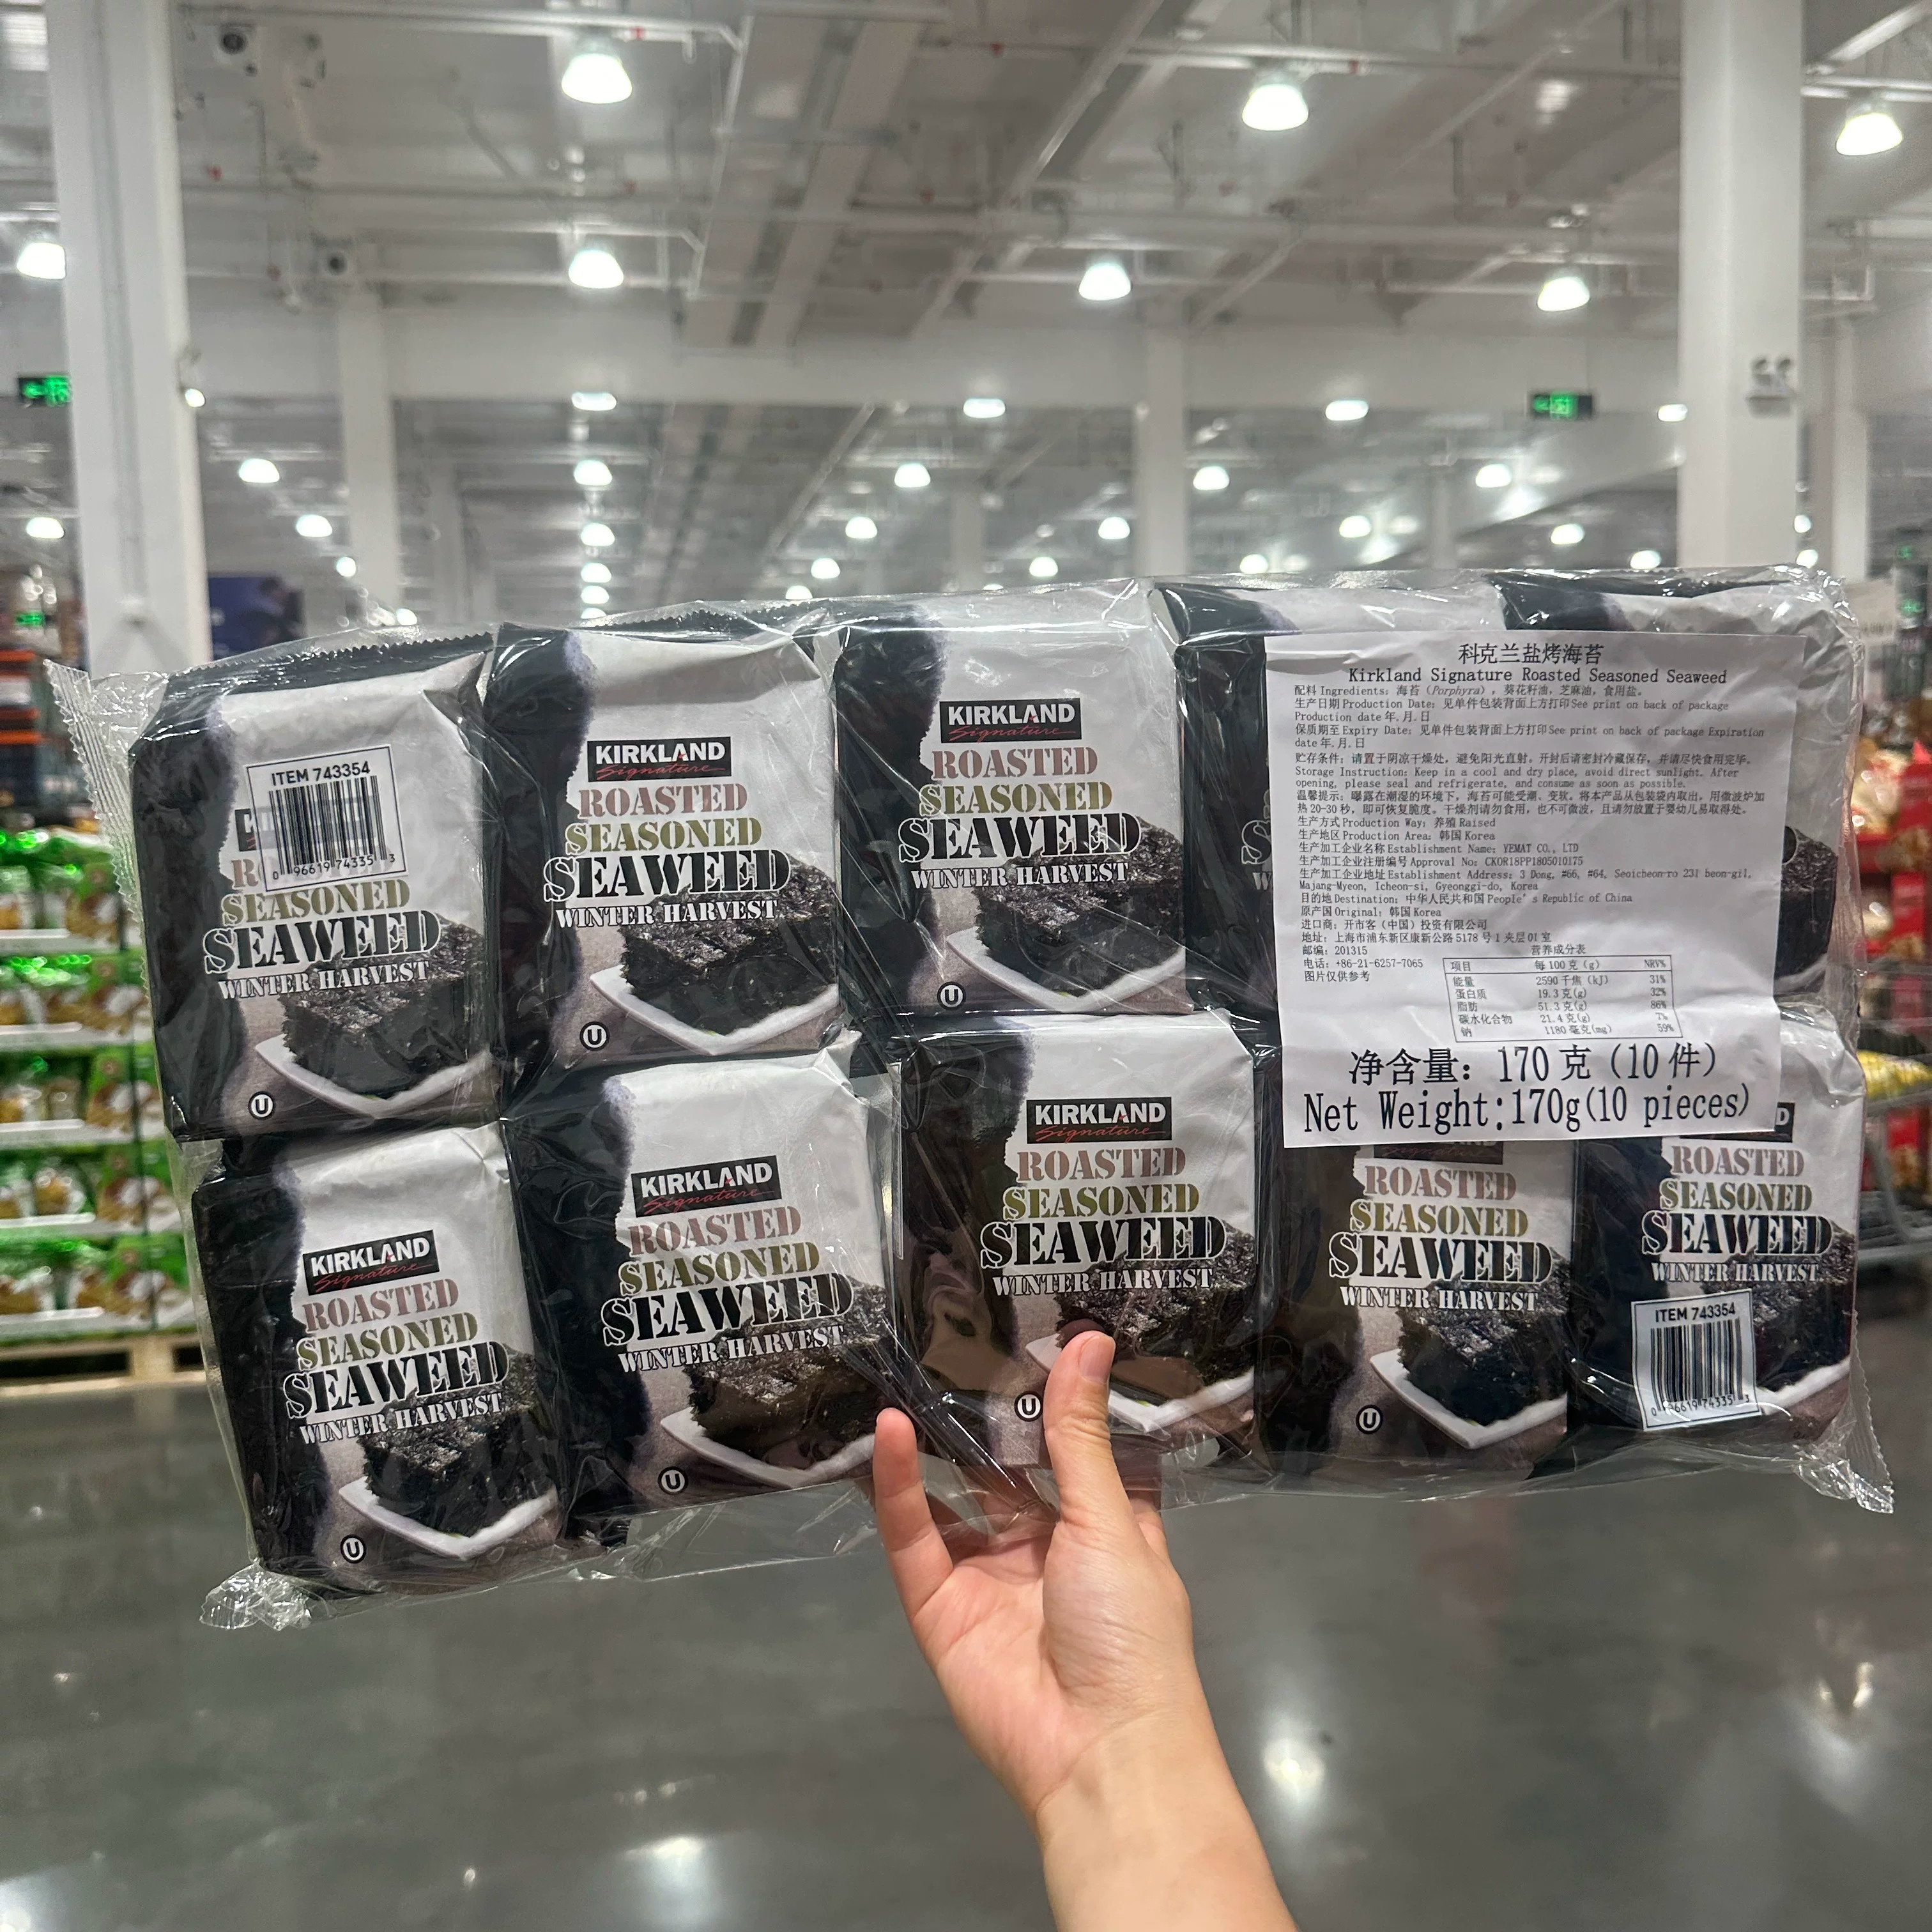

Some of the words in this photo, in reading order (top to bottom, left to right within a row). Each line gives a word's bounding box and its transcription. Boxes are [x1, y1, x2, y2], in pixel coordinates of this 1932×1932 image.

[1458, 643, 1604, 664] 科克兰盐烤海苔
[1349, 667, 1421, 682] Kirkland
[1431, 668, 1512, 684] Signature
[1522, 667, 1581, 681] Roasted
[1590, 668, 1659, 682] Seasoned
[1666, 670, 1726, 684] Seaweed
[1294, 685, 1316, 696] 配料
[1321, 686, 1388, 696] Ingredients:
[1397, 685, 1420, 696] 海苔
[949, 703, 1075, 726] KIRKLAND
[1295, 698, 1339, 709] 生产日期
[1343, 699, 1402, 709] Production
[1408, 699, 1435, 708] Date:
[1572, 699, 1588, 708] See
[1593, 700, 1620, 710] print
[1644, 700, 1666, 709] back
[1673, 700, 1683, 709] of
[1689, 701, 1729, 712] package
[949, 724, 1075, 743] Signature
[595, 742, 725, 765] KIRKLAND
[932, 746, 1098, 779] ROASTED
[272, 768, 309, 786] ITEM
[313, 762, 371, 781] 743354
[596, 763, 725, 781] Signature
[1296, 766, 1334, 778] Storage
[1340, 767, 1407, 776] Instruction:
[1414, 767, 1438, 778] Keep
[1445, 767, 1455, 776] in
[1473, 767, 1496, 776] cool
[1504, 767, 1521, 776] and
[1527, 767, 1543, 778] dry
[1549, 767, 1577, 778] place,
[1585, 767, 1613, 776] avoid
[1619, 767, 1650, 776] direct
[1657, 768, 1703, 778] sunlight.
[1711, 768, 1739, 777] After
[578, 783, 747, 818] ROASTED
[920, 781, 1112, 816] SEASONED
[565, 817, 762, 855] SEASONED
[1298, 816, 1340, 828] 生产方式
[1343, 818, 1399, 827] Production
[1406, 818, 1426, 829] Way:
[1434, 816, 1455, 828] 养殖
[1459, 818, 1495, 827] Raised
[898, 813, 1140, 862] SEAWEED
[1299, 841, 1385, 854] 生产加工企业名称
[1388, 843, 1462, 854] Establishment
[1468, 844, 1495, 854] Name:
[1503, 843, 1532, 854] YEMAT
[1537, 843, 1555, 854] CO.,
[1563, 843, 1578, 852] LTD
[272, 871, 279, 880] 0
[293, 860, 331, 877] 96619
[335, 855, 374, 869] 74335
[390, 854, 395, 863] 3
[543, 849, 790, 902] SEAWEED
[911, 868, 1008, 890] WINTER
[1017, 862, 1128, 885] HARVEST
[1411, 857, 1454, 868] Approval
[1462, 857, 1477, 866] No:
[1300, 880, 1366, 892] Majang-Myeon,
[1376, 882, 1427, 892] Icheon-si,
[1436, 882, 1502, 892] Gyeonggi-do,
[1511, 882, 1538, 891] Korea
[1302, 893, 1331, 903] 目的地
[1335, 894, 1398, 903] Destination:
[1406, 893, 1483, 905] 中华人民共和国
[1542, 893, 1583, 904] Republic
[1590, 893, 1600, 902] of
[1606, 893, 1632, 902] China
[221, 878, 410, 926] SEASONED
[556, 905, 654, 928] WINTER
[664, 900, 777, 923] HARVEST
[1301, 906, 1331, 916] 原产国
[1335, 907, 1381, 918] Original:
[1390, 906, 1411, 917] 韩国
[1414, 907, 1441, 916] Korea
[203, 910, 441, 974] SEAWEED
[1303, 944, 1328, 956] 邮编：
[1335, 946, 1367, 954] 201315
[1531, 944, 1586, 955] 营养成分表
[1304, 957, 1329, 969] 电话：
[1336, 958, 1423, 968] +86-21-6257-7065
[1305, 970, 1370, 982] 图片仅供参考
[1450, 961, 1471, 971] 项目
[1535, 960, 1545, 970] 每
[1549, 961, 1565, 969] 100
[1644, 960, 1666, 968] NRV%
[218, 972, 311, 999] WINTER
[319, 962, 429, 990] HARVEST
[1453, 976, 1475, 987] 能量
[1536, 976, 1558, 985] 2590
[1650, 975, 1666, 984] 31%
[1457, 1002, 1477, 1012] 脂肪
[1538, 1002, 1560, 1011] 51.3
[1651, 1000, 1666, 1009] 86%
[1349, 1048, 1469, 1086] 净含量：
[1498, 1046, 1549, 1082] 170
[1035, 1103, 1166, 1124] KIRKLAND
[1304, 1093, 1358, 1132] Net
[1644, 1084, 1748, 1127] pieces)
[1035, 1124, 1166, 1144] Signature
[1017, 1147, 1185, 1181] ROASTED
[1671, 1146, 1804, 1177] ROASTED
[641, 1163, 773, 1198] KIRKLAND
[1365, 1165, 1516, 1200] ROASTED
[1660, 1178, 1813, 1211] SEASONED
[643, 1188, 775, 1215] Signature
[1003, 1183, 1199, 1220] SEASONED
[628, 1206, 801, 1257] ROASTED
[1350, 1199, 1528, 1237] SEASONED
[981, 1216, 1226, 1269] SEAWEED
[1642, 1210, 1832, 1255] SEAWEED
[311, 1238, 430, 1276] KIRKLAND
[618, 1241, 820, 1296] SEASONED
[1329, 1231, 1552, 1284] SEAWEED
[315, 1262, 433, 1292] Signature
[992, 1273, 1090, 1296] WINTER
[1100, 1268, 1213, 1290] HARVEST
[1652, 1262, 1729, 1282] WINTER
[1735, 1263, 1820, 1282] HARVEST
[302, 1278, 459, 1334] ROASTED
[602, 1272, 853, 1346] SEAWEED
[1340, 1286, 1429, 1308] WINTER
[1438, 1288, 1538, 1312] HARVEST
[1655, 1308, 1687, 1322] ITEM
[1691, 1302, 1735, 1320] 743354
[296, 1312, 478, 1372] SEASONED
[618, 1342, 719, 1373] WINTER
[726, 1326, 844, 1358] HARVEST
[283, 1341, 509, 1418] SEAWEED
[300, 1413, 388, 1445] WINTER
[396, 1393, 503, 1430] HARVEST
